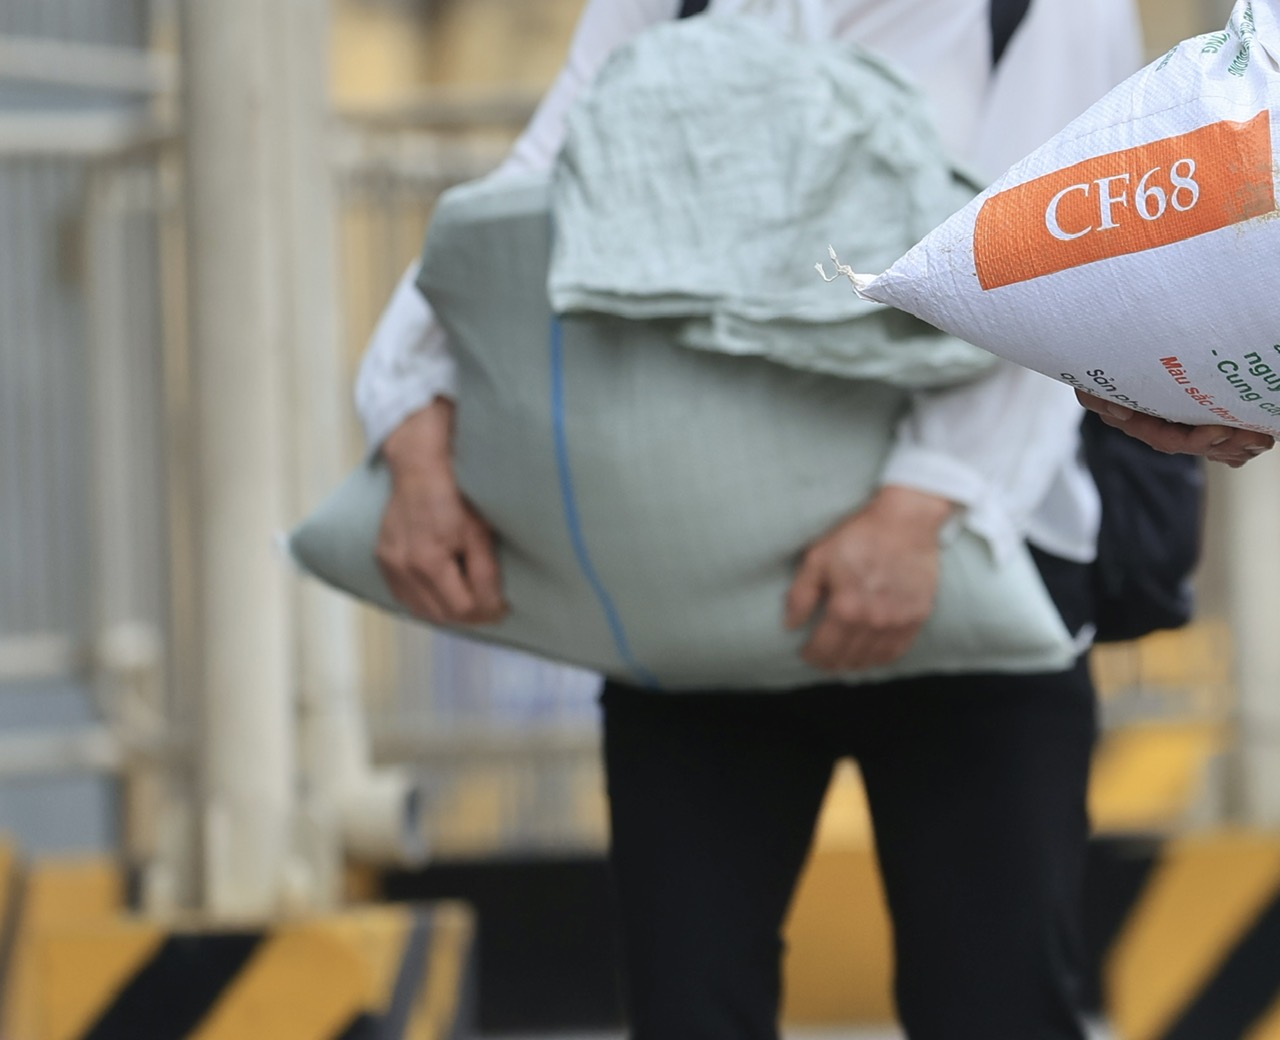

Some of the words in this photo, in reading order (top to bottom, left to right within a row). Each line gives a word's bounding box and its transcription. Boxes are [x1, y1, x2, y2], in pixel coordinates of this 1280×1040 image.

[1044, 158, 1200, 241] CF68
[1086, 368, 1118, 393] Sản
[1184, 386, 1215, 407] sắc
[1217, 359, 1263, 403] Cung
